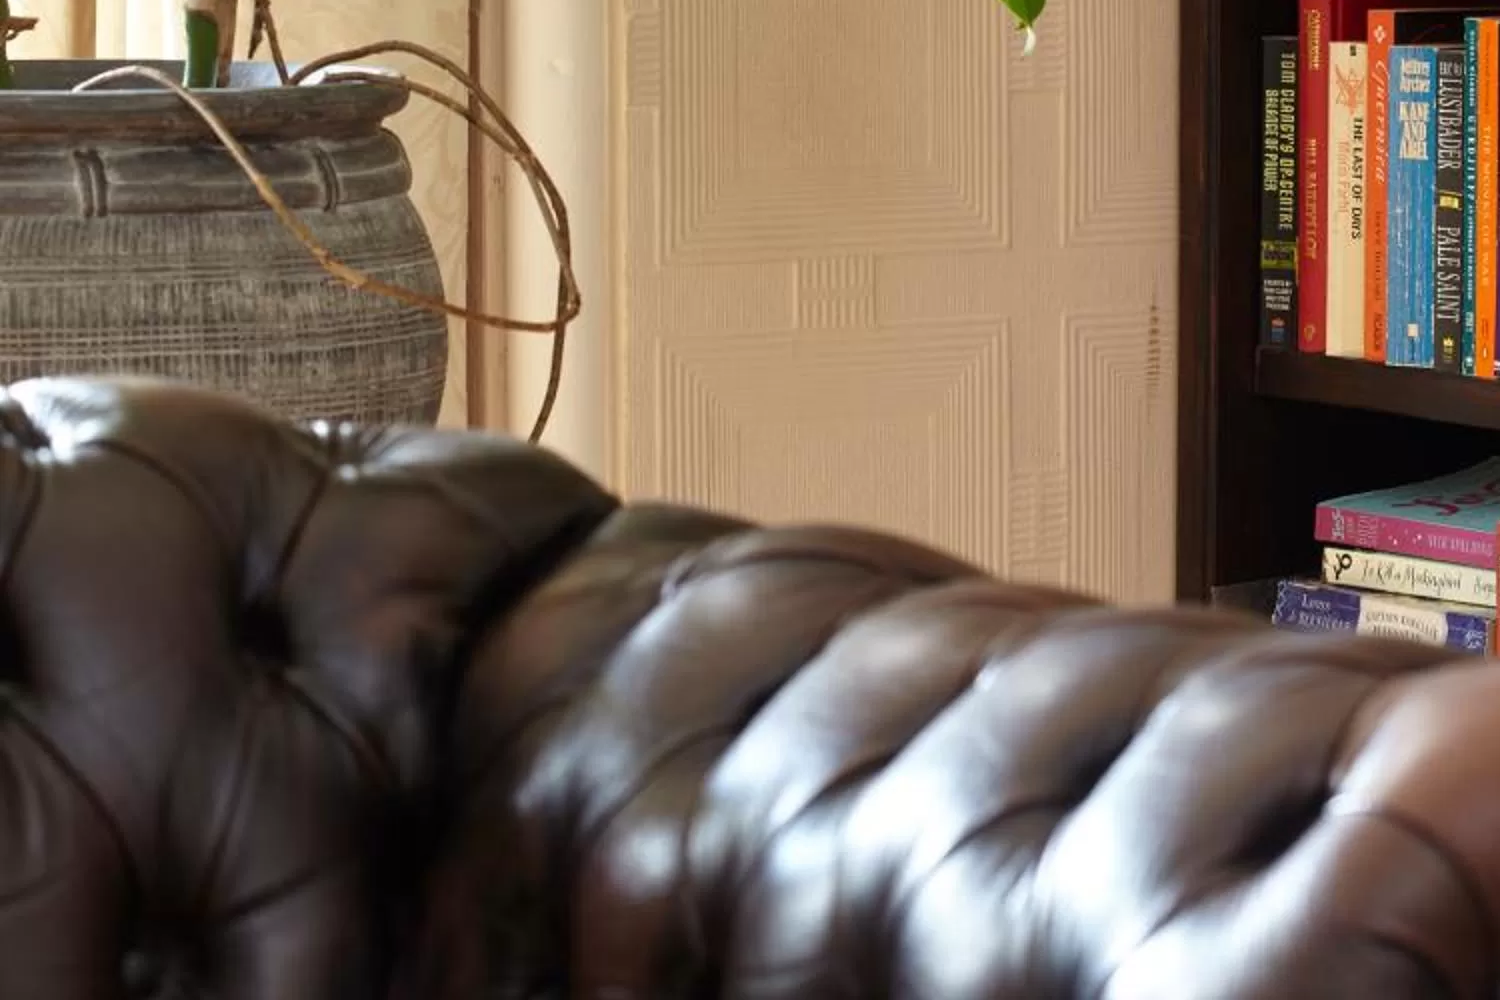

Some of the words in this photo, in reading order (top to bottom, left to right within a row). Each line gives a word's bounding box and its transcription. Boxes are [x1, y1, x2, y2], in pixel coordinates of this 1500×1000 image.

[1353, 117, 1363, 144] THE
[1438, 78, 1461, 169] LUSTBADER
[1352, 149, 1362, 180] LAST
[1352, 186, 1362, 200] OF
[1351, 205, 1362, 240] DAYS
[1437, 226, 1461, 267] PALE
[1437, 272, 1461, 322] SAINT
